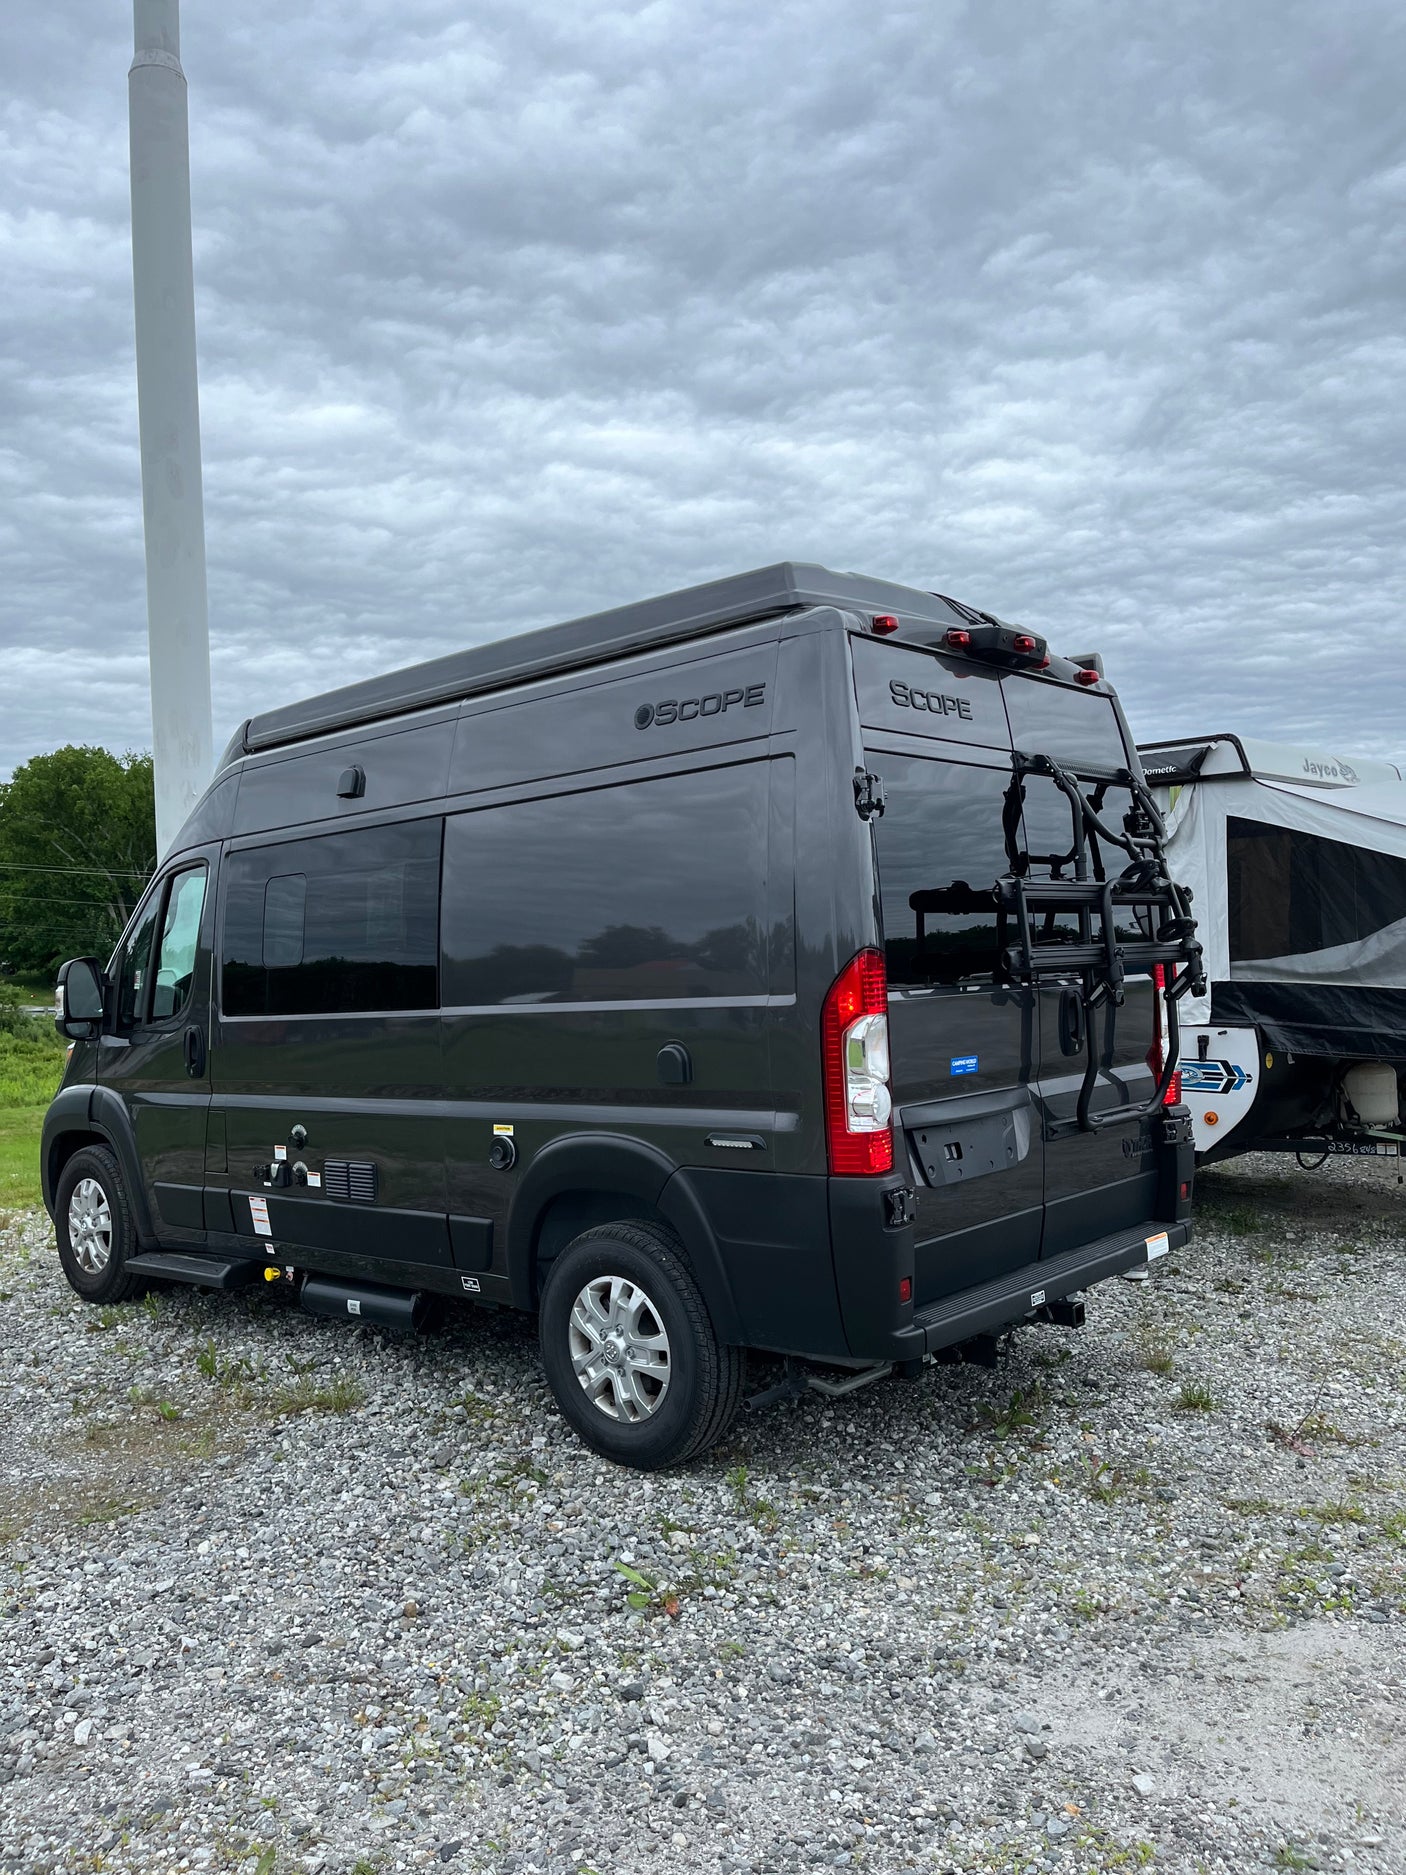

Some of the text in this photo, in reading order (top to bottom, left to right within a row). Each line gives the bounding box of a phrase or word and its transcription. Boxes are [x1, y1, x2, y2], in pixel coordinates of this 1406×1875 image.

[654, 682, 767, 726] SCOPE
[889, 679, 974, 721] SCOPE
[1302, 757, 1338, 778] Jayco
